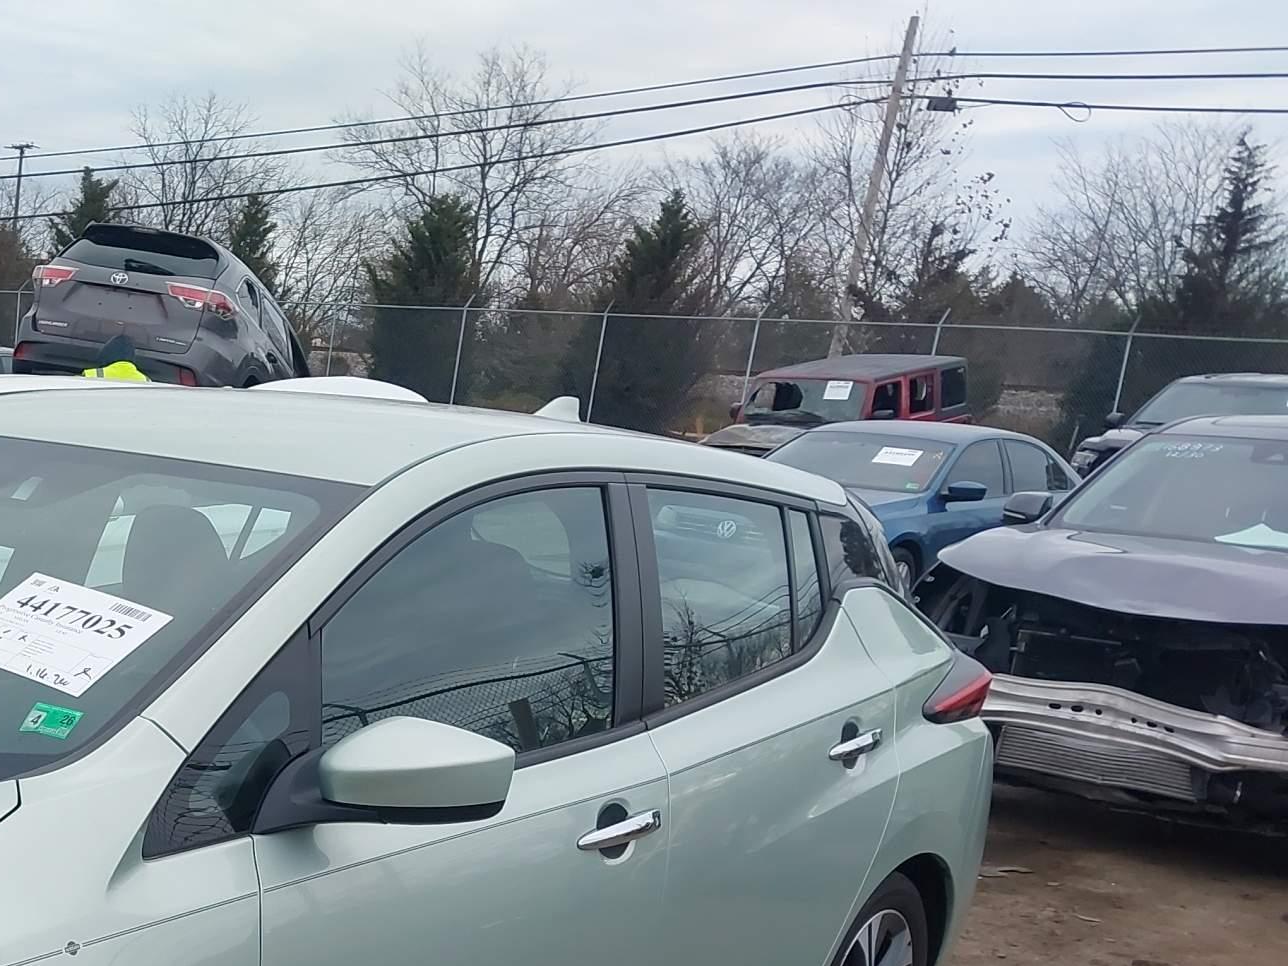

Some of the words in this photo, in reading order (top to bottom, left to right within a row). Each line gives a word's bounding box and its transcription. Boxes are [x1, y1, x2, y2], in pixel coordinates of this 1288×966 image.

[16, 594, 134, 640] 44177025
[29, 714, 43, 726] 4
[58, 713, 76, 726] 26
